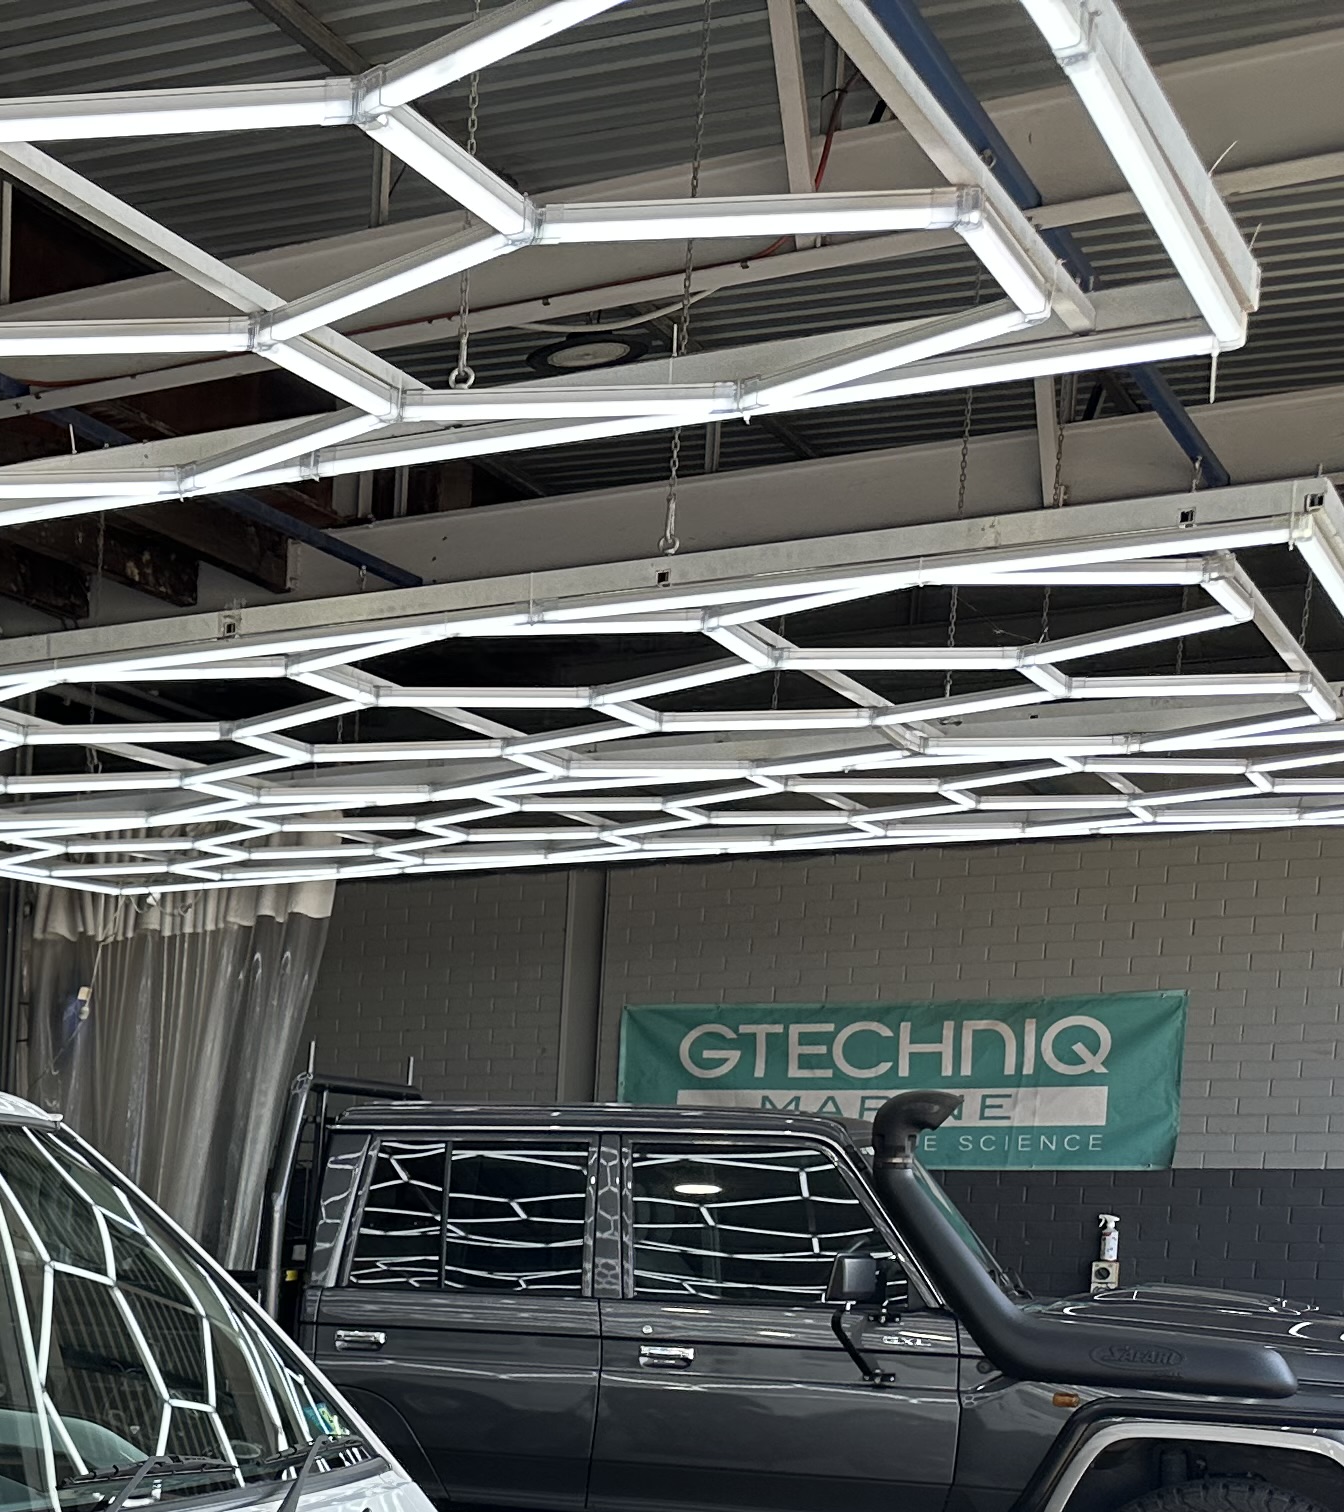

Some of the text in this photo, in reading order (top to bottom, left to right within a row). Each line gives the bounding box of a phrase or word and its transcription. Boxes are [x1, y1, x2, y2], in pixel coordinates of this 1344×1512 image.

[678, 1014, 1113, 1079] GTECHNIQ
[761, 1093, 1012, 1121] MARE
[958, 1134, 1104, 1151] SCIENCE
